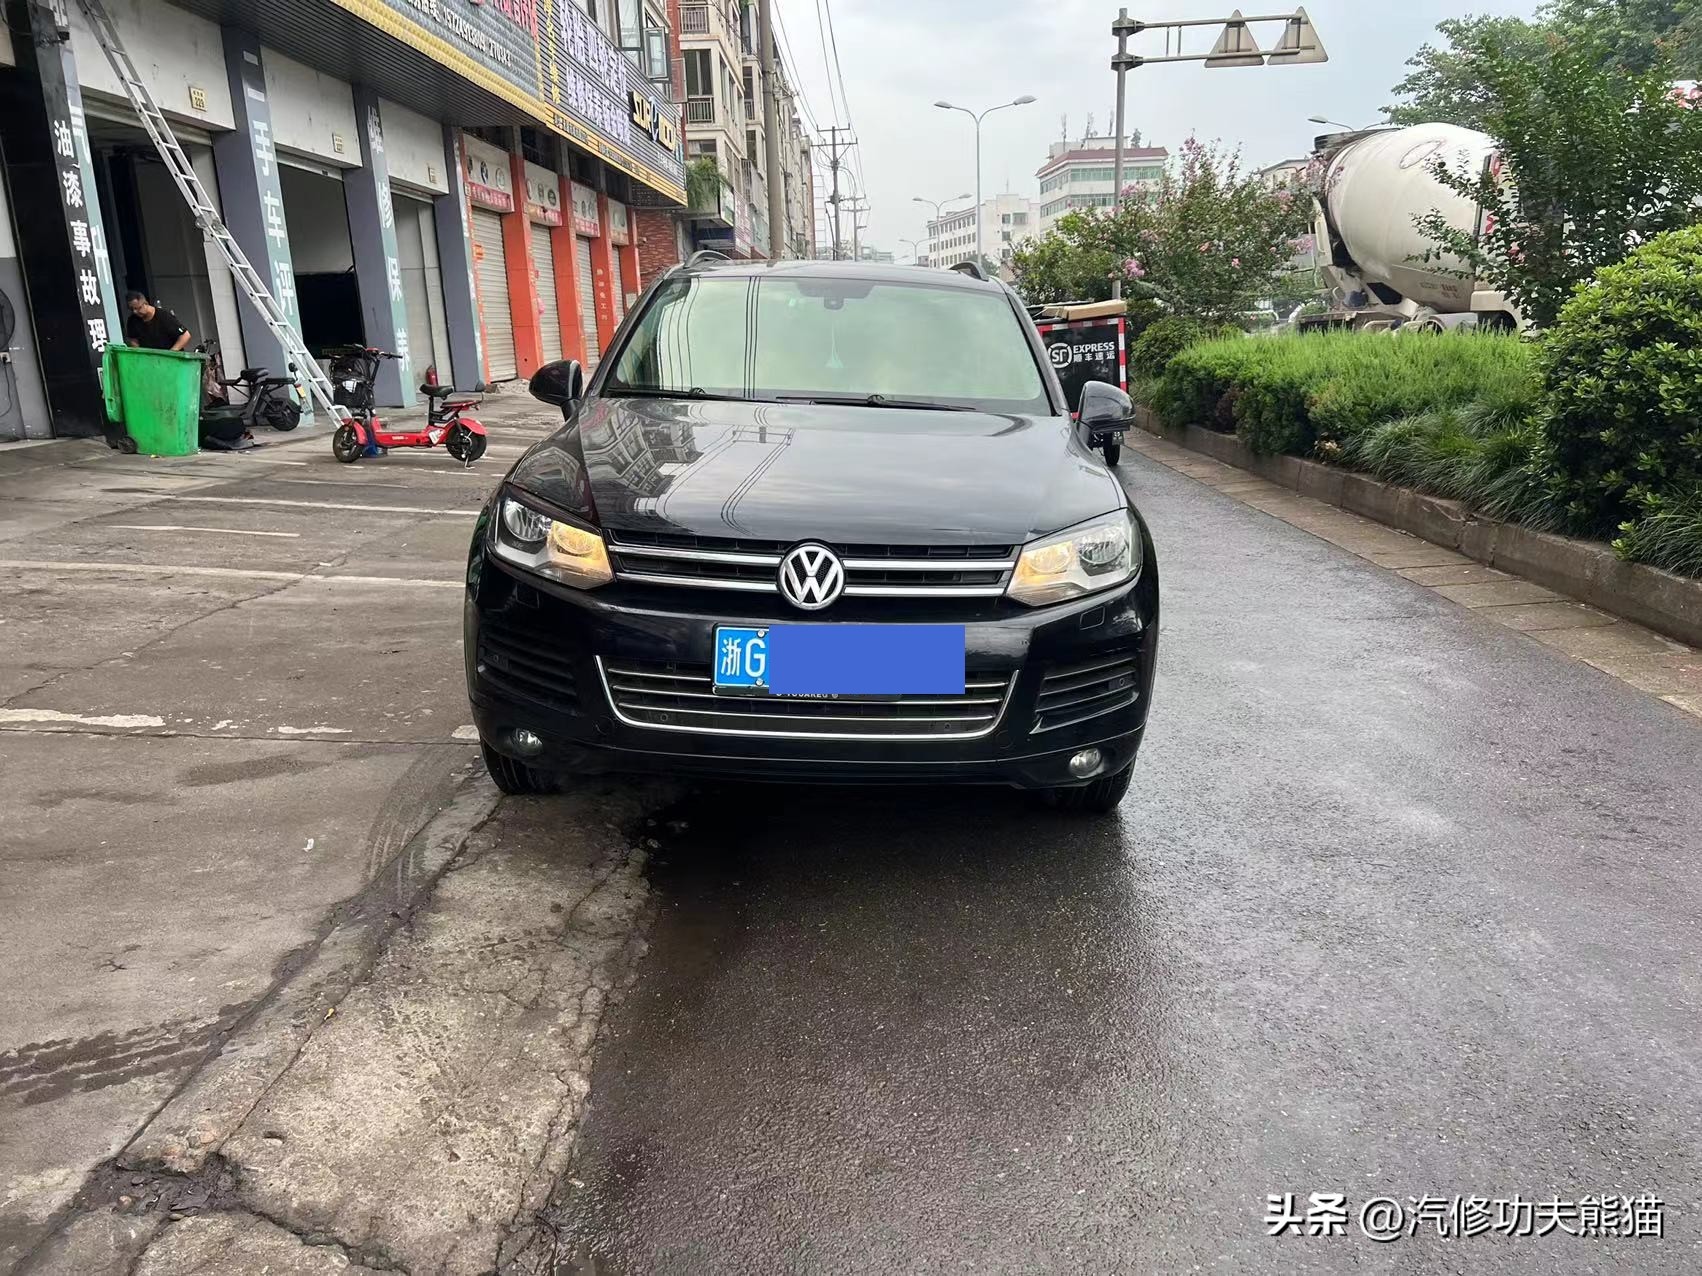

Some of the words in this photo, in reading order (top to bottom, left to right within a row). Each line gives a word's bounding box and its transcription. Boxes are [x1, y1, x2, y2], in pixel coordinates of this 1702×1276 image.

[54, 119, 108, 394] 油漆事故理
[243, 50, 304, 372] 二手车评
[367, 105, 410, 372] 维修保养
[1073, 341, 1115, 354] EXPRESS
[1073, 351, 1116, 363] 顺丰速运
